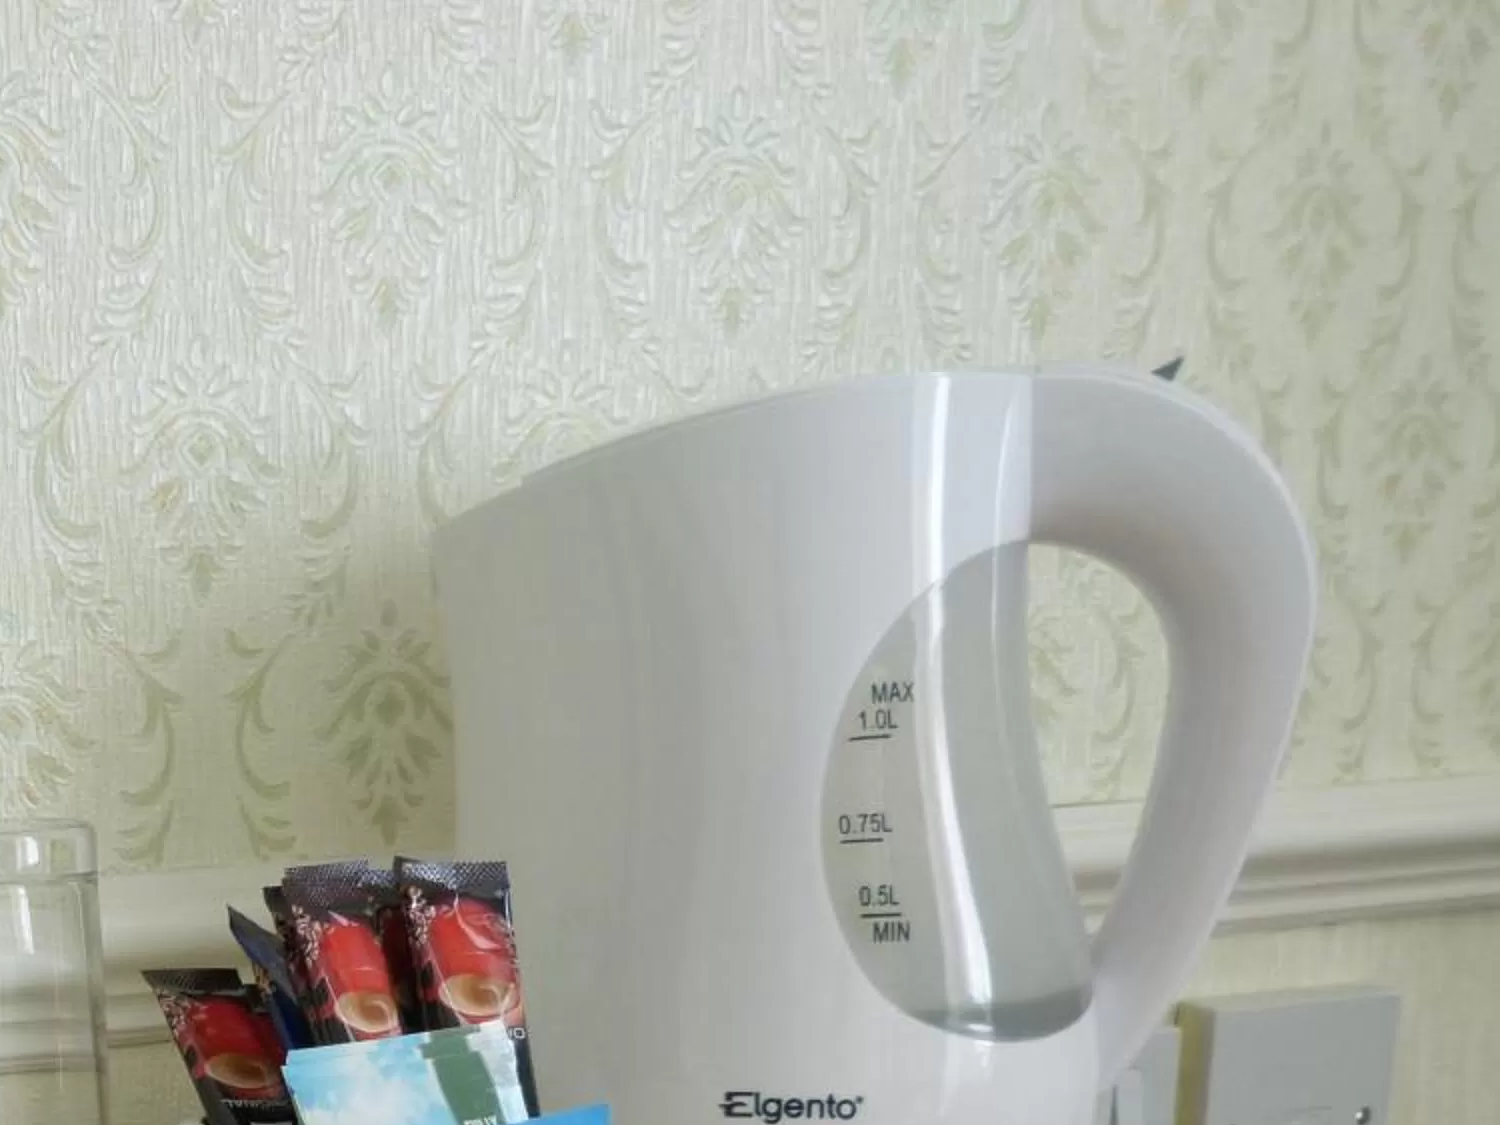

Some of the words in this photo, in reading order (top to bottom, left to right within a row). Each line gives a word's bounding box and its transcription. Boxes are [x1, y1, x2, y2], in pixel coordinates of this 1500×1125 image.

[871, 681, 915, 704] MAX
[858, 709, 899, 731] 1.0L
[838, 813, 893, 834] 0.75L
[858, 883, 901, 907] 0.5L
[872, 920, 912, 944] MIN
[718, 1091, 858, 1125] Elgento
